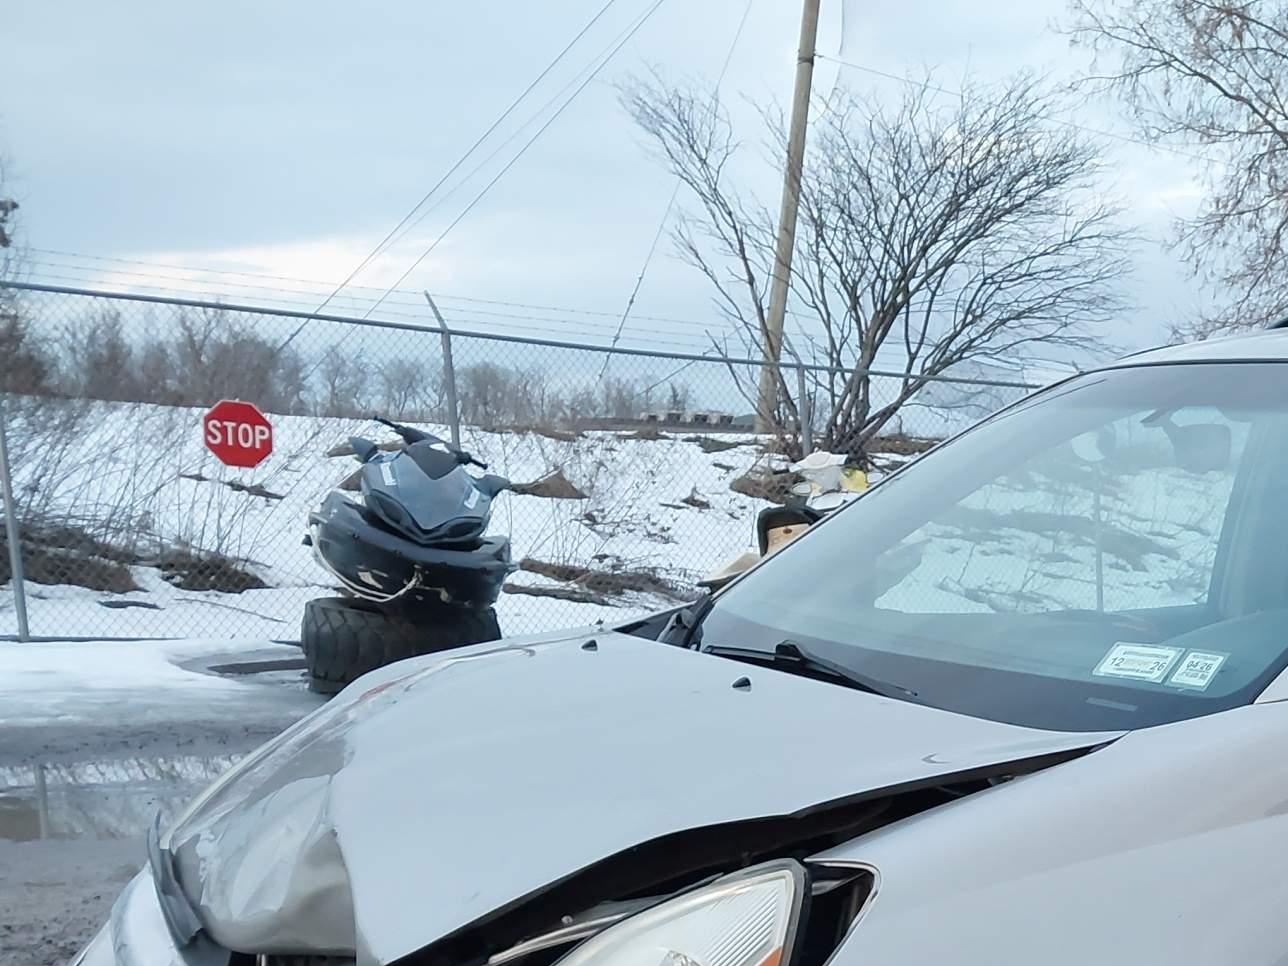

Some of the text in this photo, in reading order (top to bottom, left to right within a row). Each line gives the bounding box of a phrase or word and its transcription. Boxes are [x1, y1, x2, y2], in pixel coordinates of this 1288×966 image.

[207, 419, 270, 449] STOP
[1110, 656, 1125, 667] 12
[1150, 661, 1167, 672] 26
